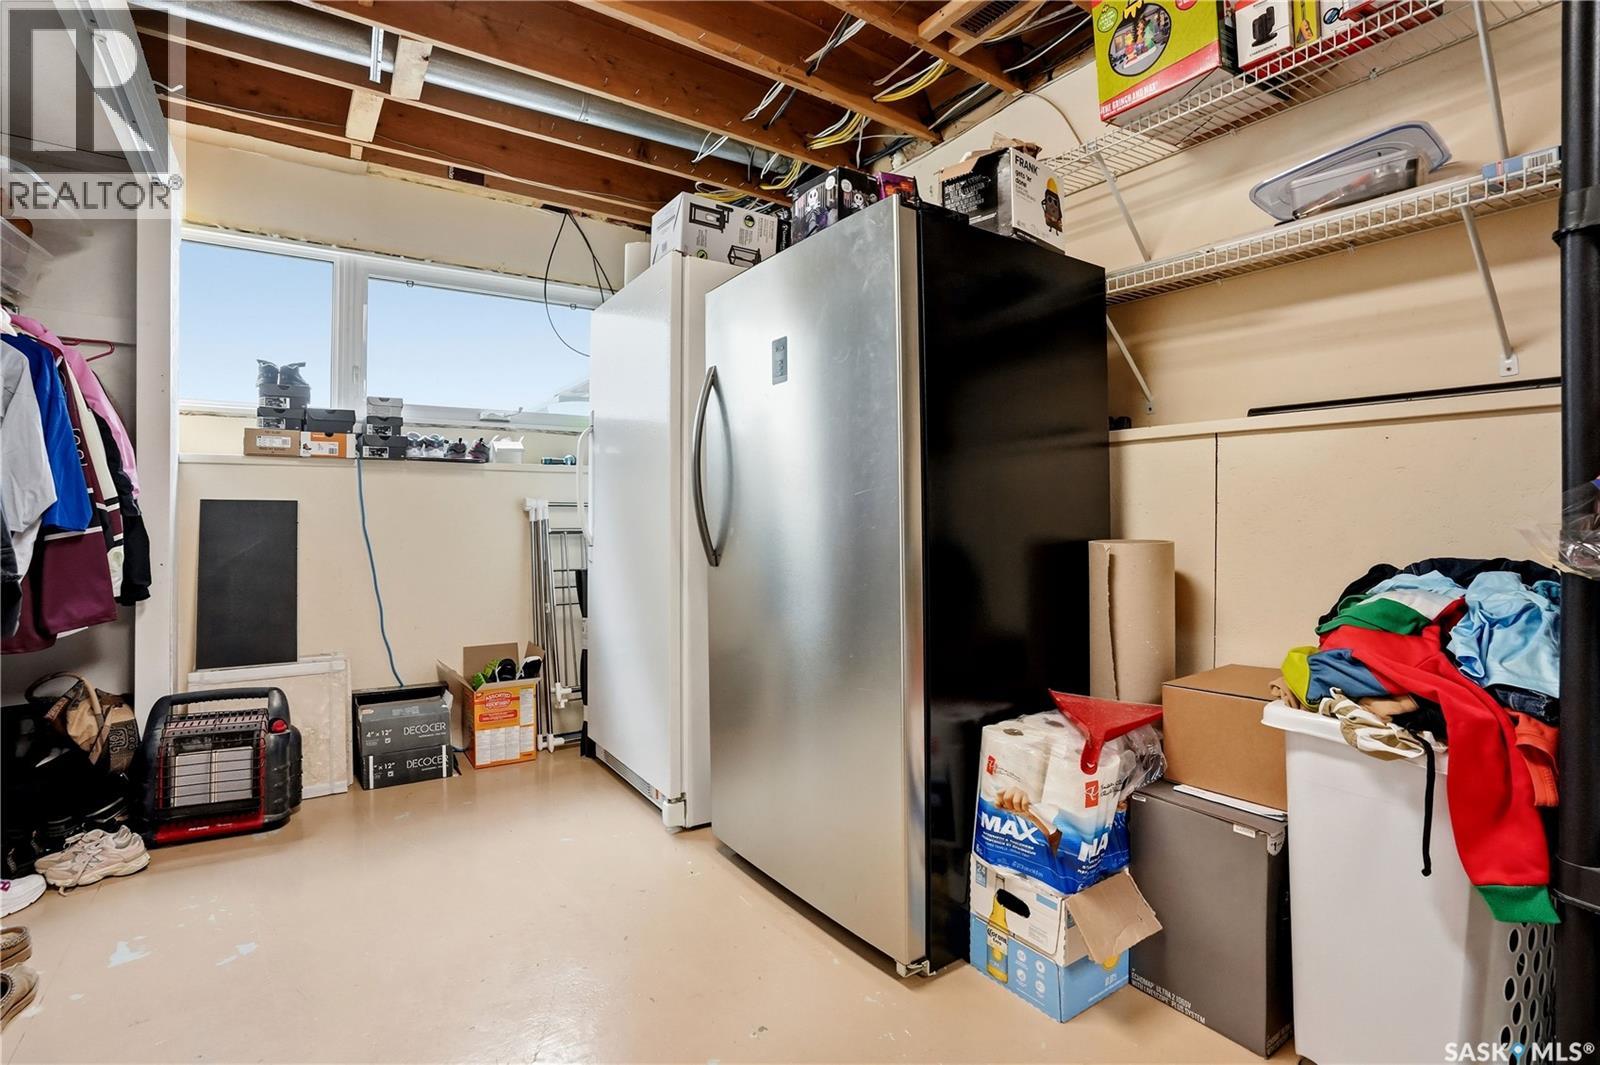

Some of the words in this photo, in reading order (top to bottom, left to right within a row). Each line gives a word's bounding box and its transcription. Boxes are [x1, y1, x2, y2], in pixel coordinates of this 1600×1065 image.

[1015, 155, 1039, 176] FRANK
[403, 722, 447, 736] DECOCER
[980, 812, 1040, 844] MAX
[1078, 834, 1109, 862] MA
[1184, 1007, 1206, 1024] SYSTEM
